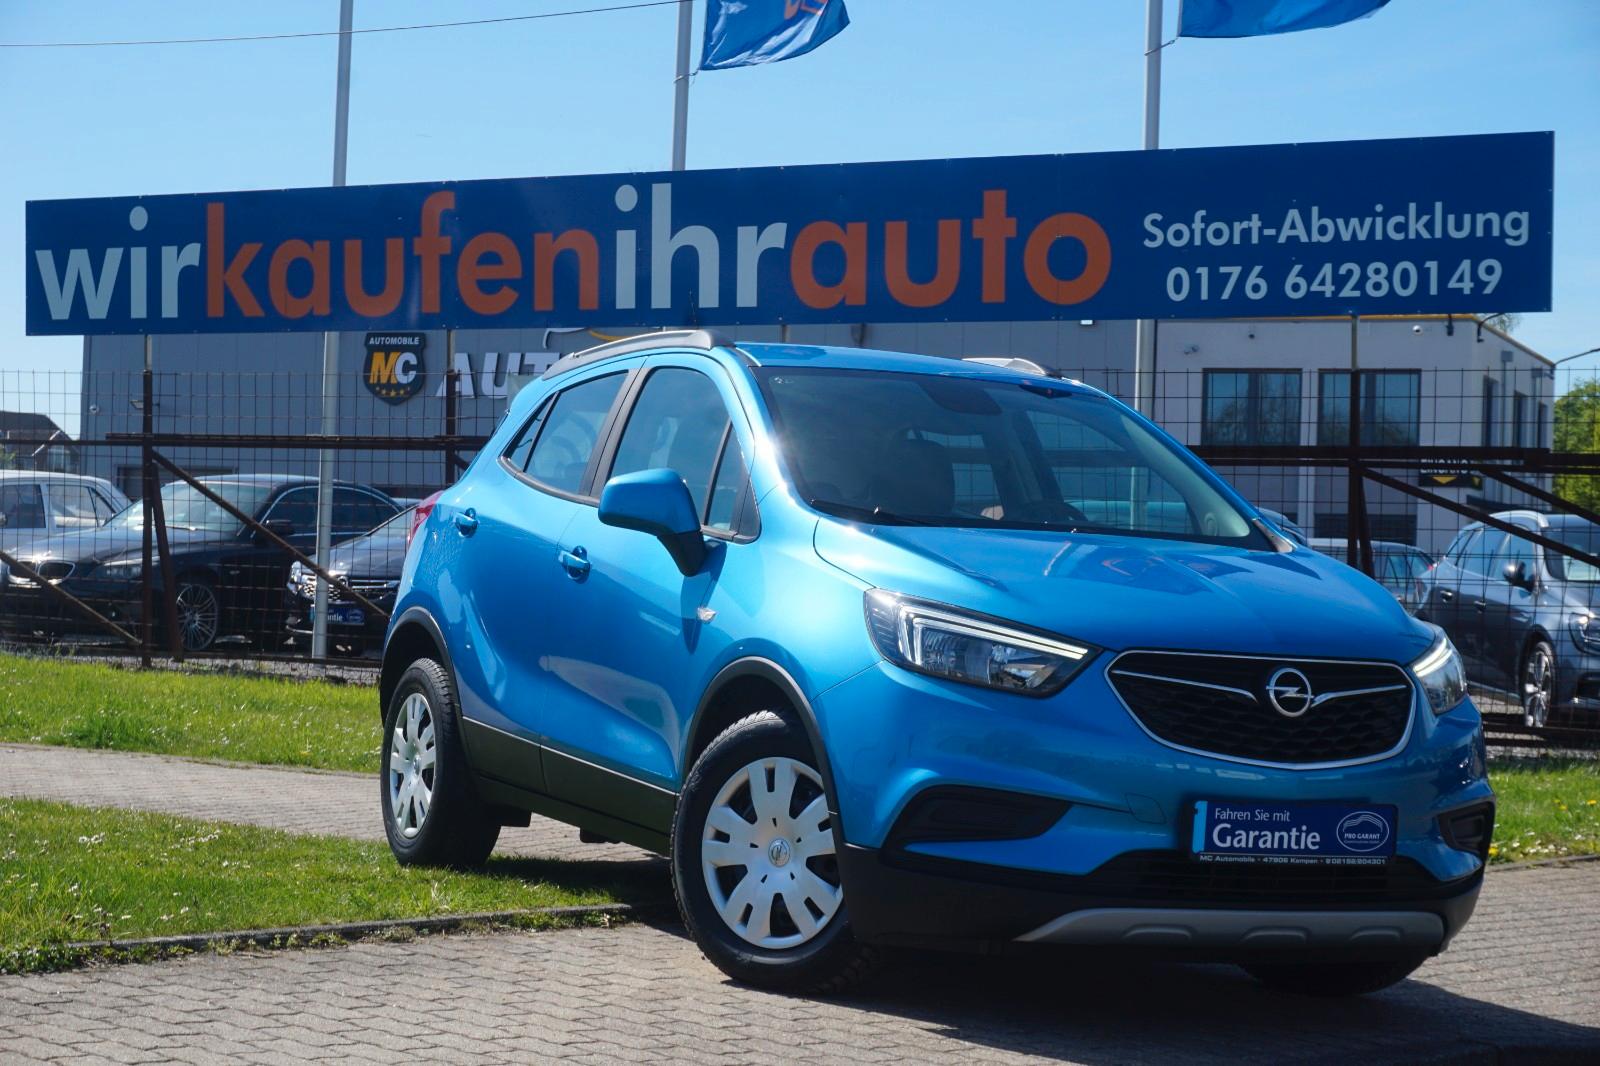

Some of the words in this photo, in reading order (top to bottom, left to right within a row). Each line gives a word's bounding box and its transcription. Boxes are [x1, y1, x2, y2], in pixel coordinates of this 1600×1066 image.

[1143, 201, 1530, 248] Sofort-Abwicklung
[1166, 265, 1268, 302] 0176
[1284, 258, 1503, 299] 64280149
[369, 336, 420, 346] AUTOMOBILE
[369, 351, 418, 385] MC
[1214, 808, 1251, 821] Fahren
[1254, 809, 1270, 821] Sie
[1272, 810, 1291, 822] mit
[1212, 823, 1321, 850] Garantie
[1214, 855, 1255, 863] Automobile
